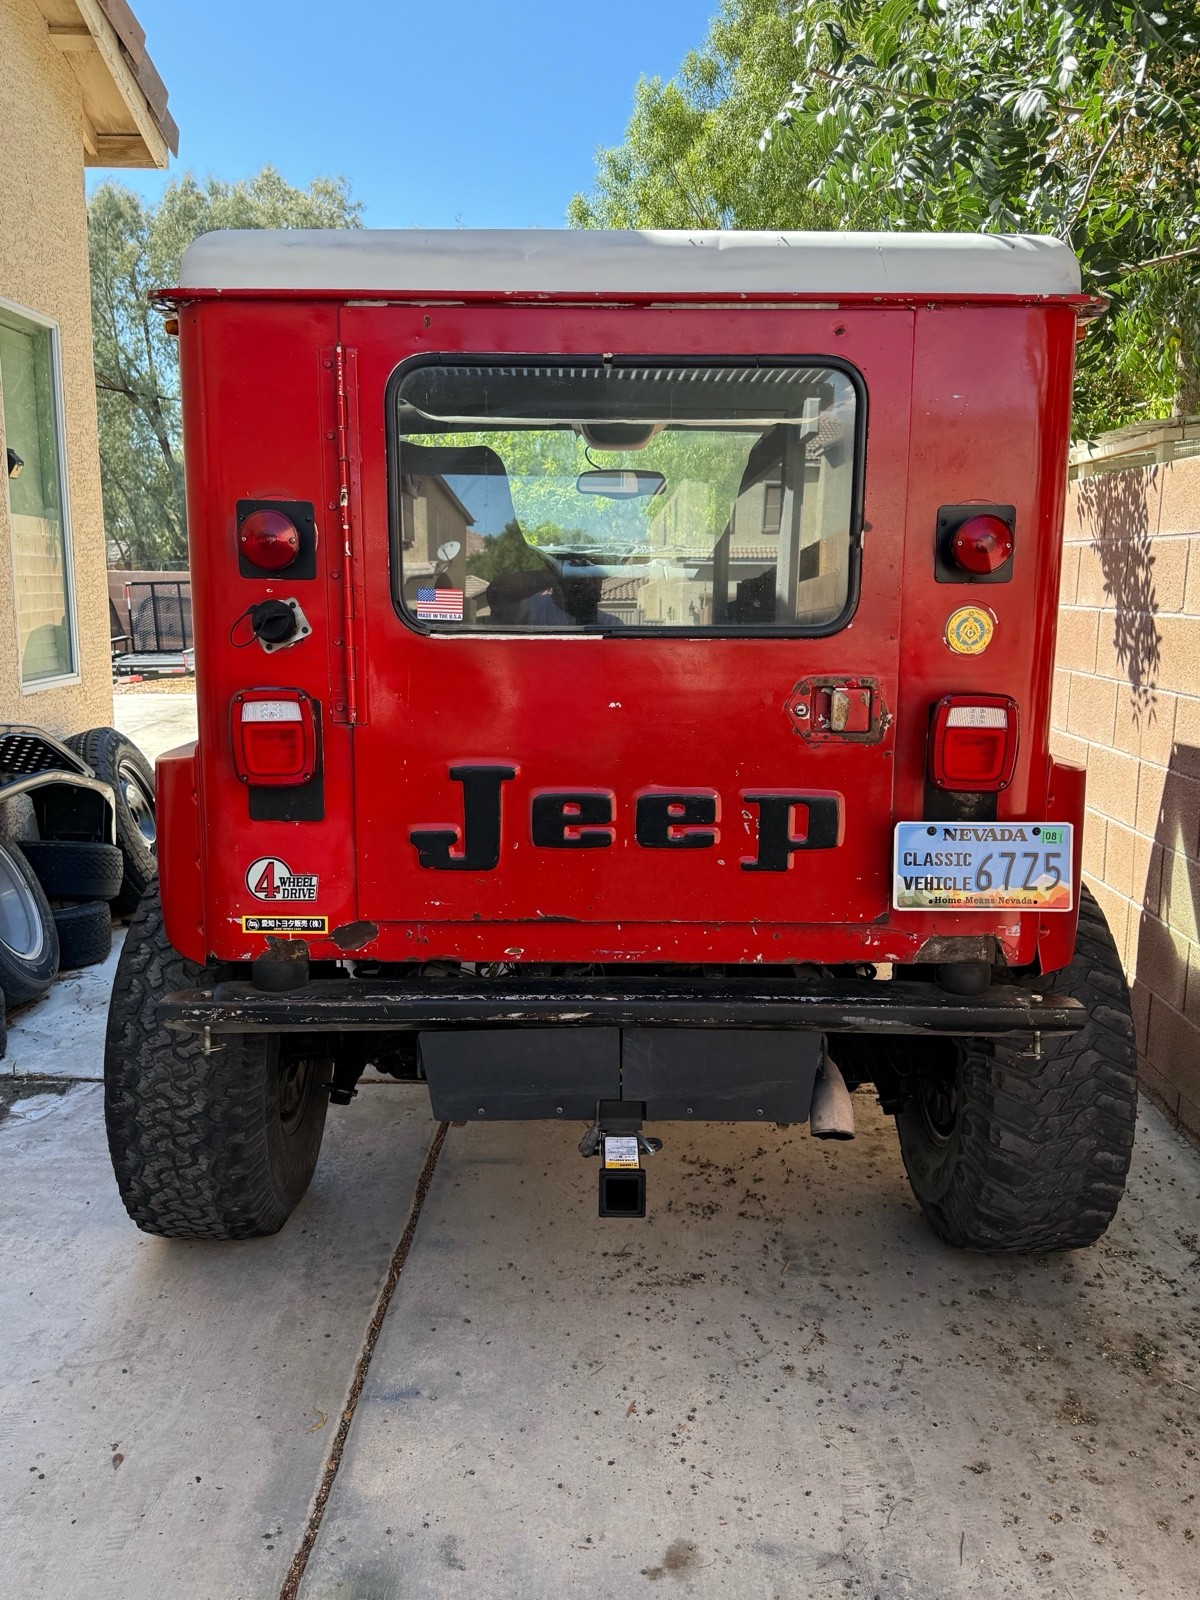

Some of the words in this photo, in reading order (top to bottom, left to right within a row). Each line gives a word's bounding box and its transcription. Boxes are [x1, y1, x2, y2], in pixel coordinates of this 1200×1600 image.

[408, 763, 846, 872] Jeep
[942, 828, 1028, 842] NEVADA
[1045, 831, 1057, 840] 08
[903, 852, 972, 867] CLASSIC
[254, 861, 281, 899] 4
[279, 876, 316, 888] WHEEL
[903, 876, 973, 891] VEHICLE
[282, 888, 316, 899] DRIVE
[934, 896, 962, 905] Home
[965, 897, 995, 905] Means
[998, 897, 1032, 905] Nevada
